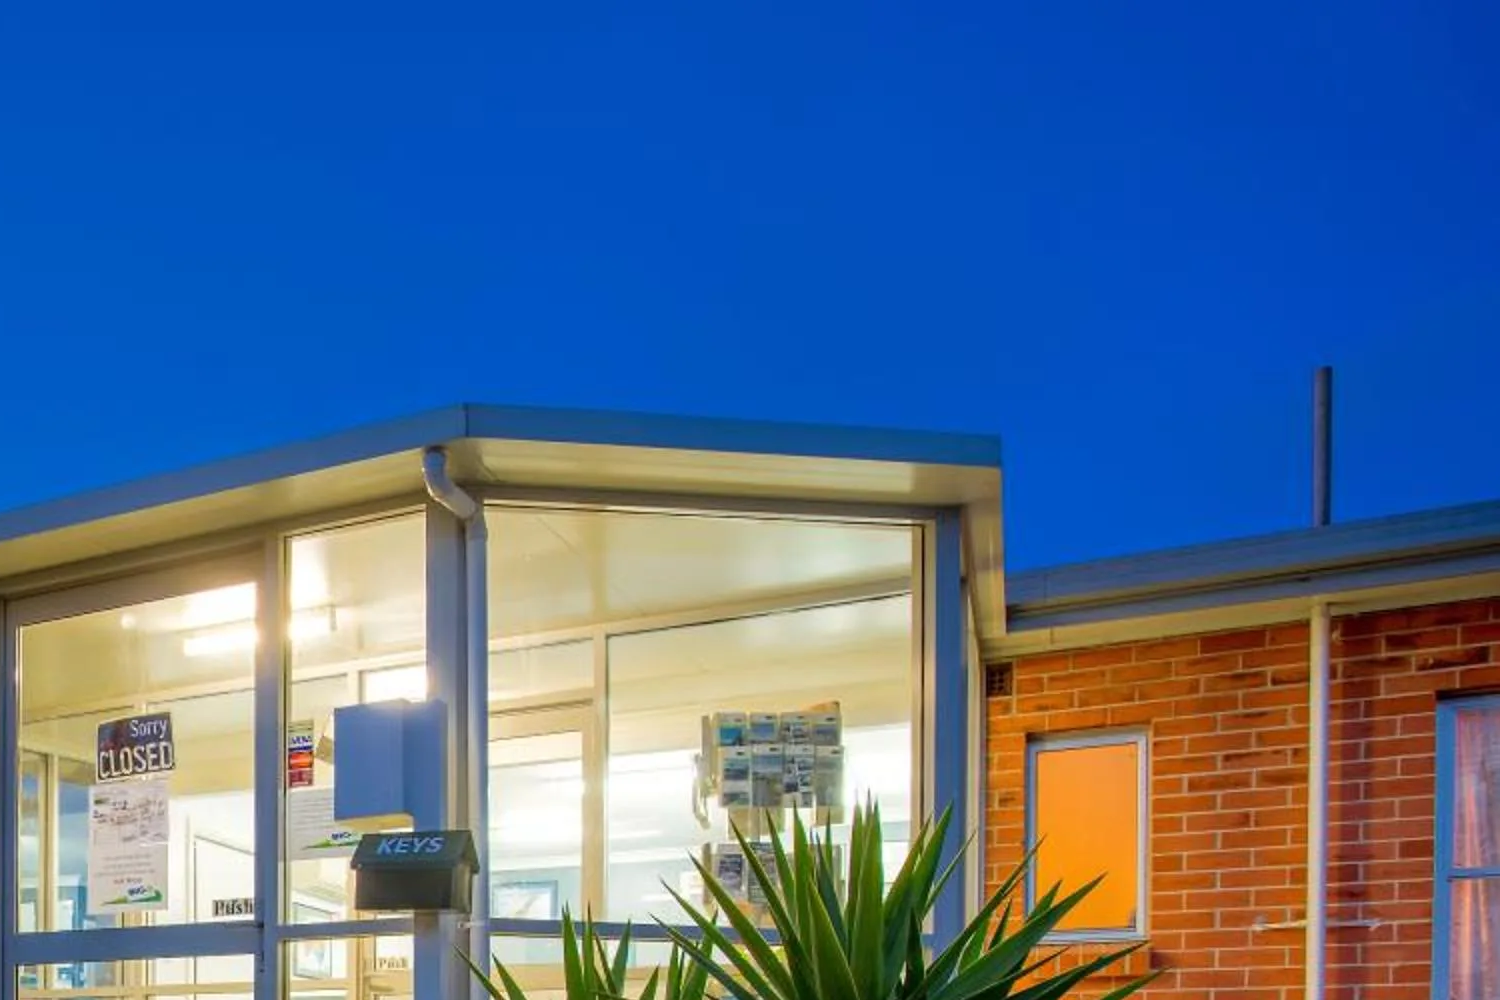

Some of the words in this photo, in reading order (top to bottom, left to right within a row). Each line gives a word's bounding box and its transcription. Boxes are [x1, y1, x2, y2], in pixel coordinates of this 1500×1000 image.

[131, 719, 167, 737] Sorry
[100, 742, 172, 777] CLOSED
[378, 837, 443, 853] KEYS
